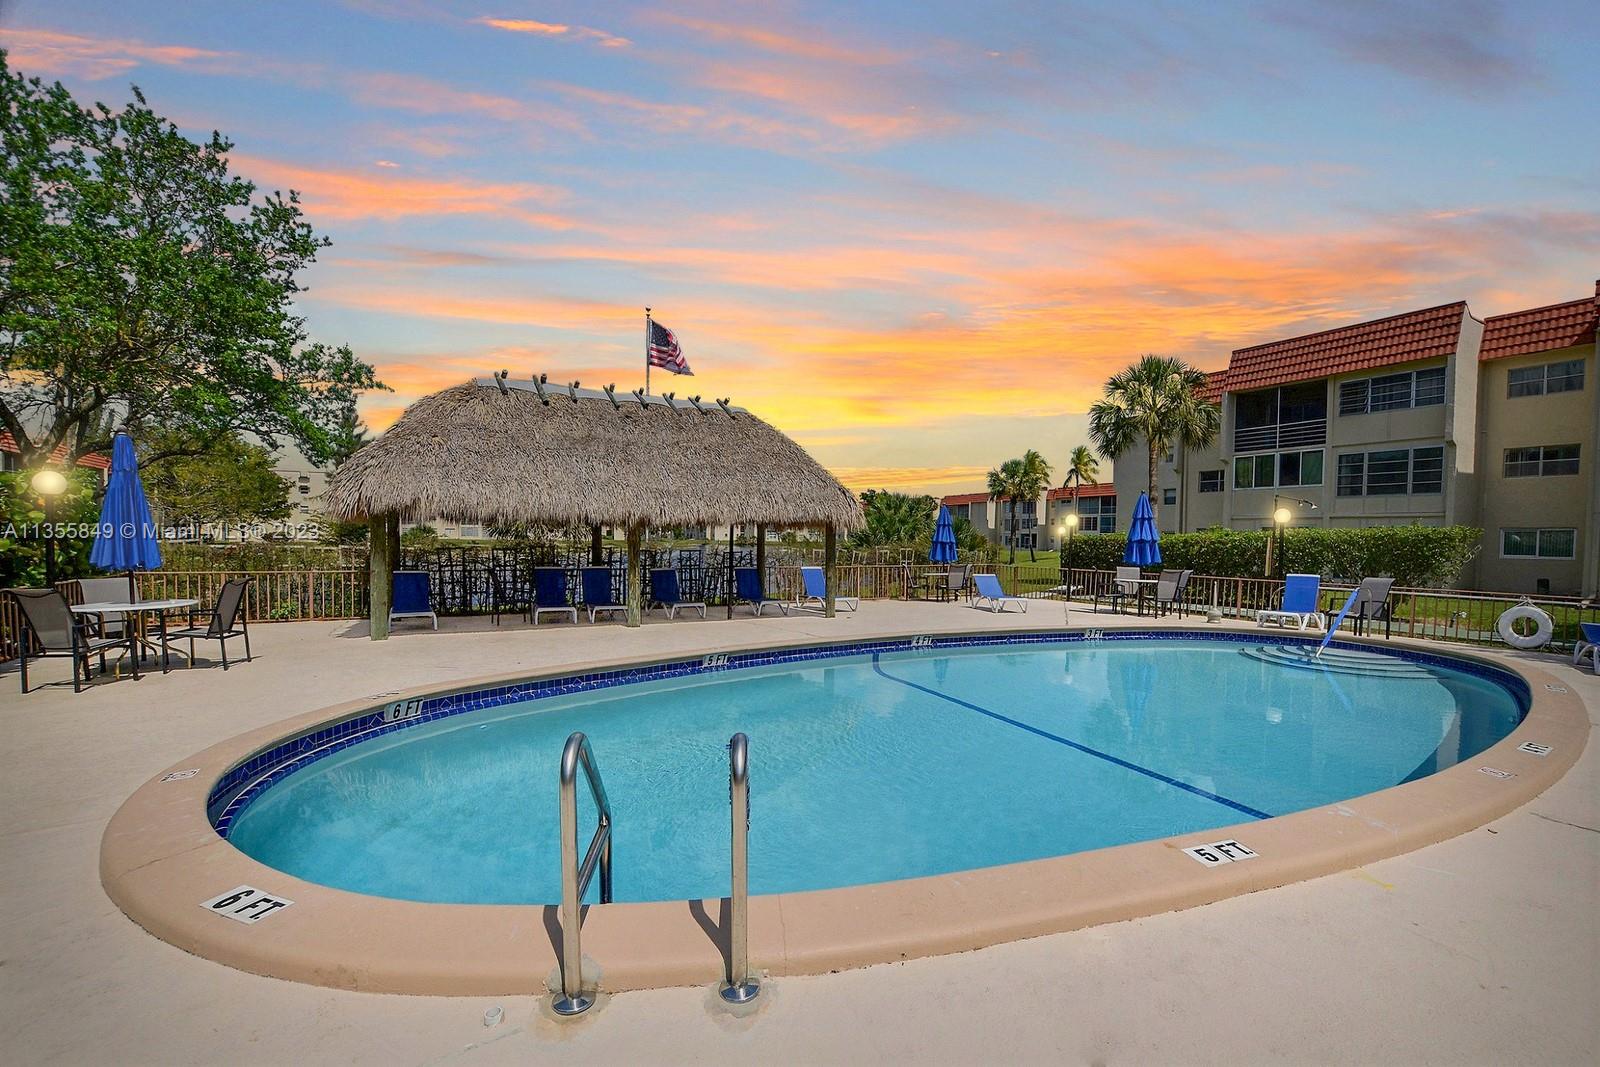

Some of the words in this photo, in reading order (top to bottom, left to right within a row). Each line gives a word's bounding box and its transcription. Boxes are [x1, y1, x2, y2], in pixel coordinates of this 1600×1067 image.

[915, 636, 921, 645] 4
[921, 636, 932, 645] FT
[708, 655, 714, 666] 5
[715, 653, 729, 665] FT
[393, 703, 402, 719] 6
[405, 698, 424, 716] FT
[1193, 848, 1219, 862] 5
[212, 889, 255, 909] 6
